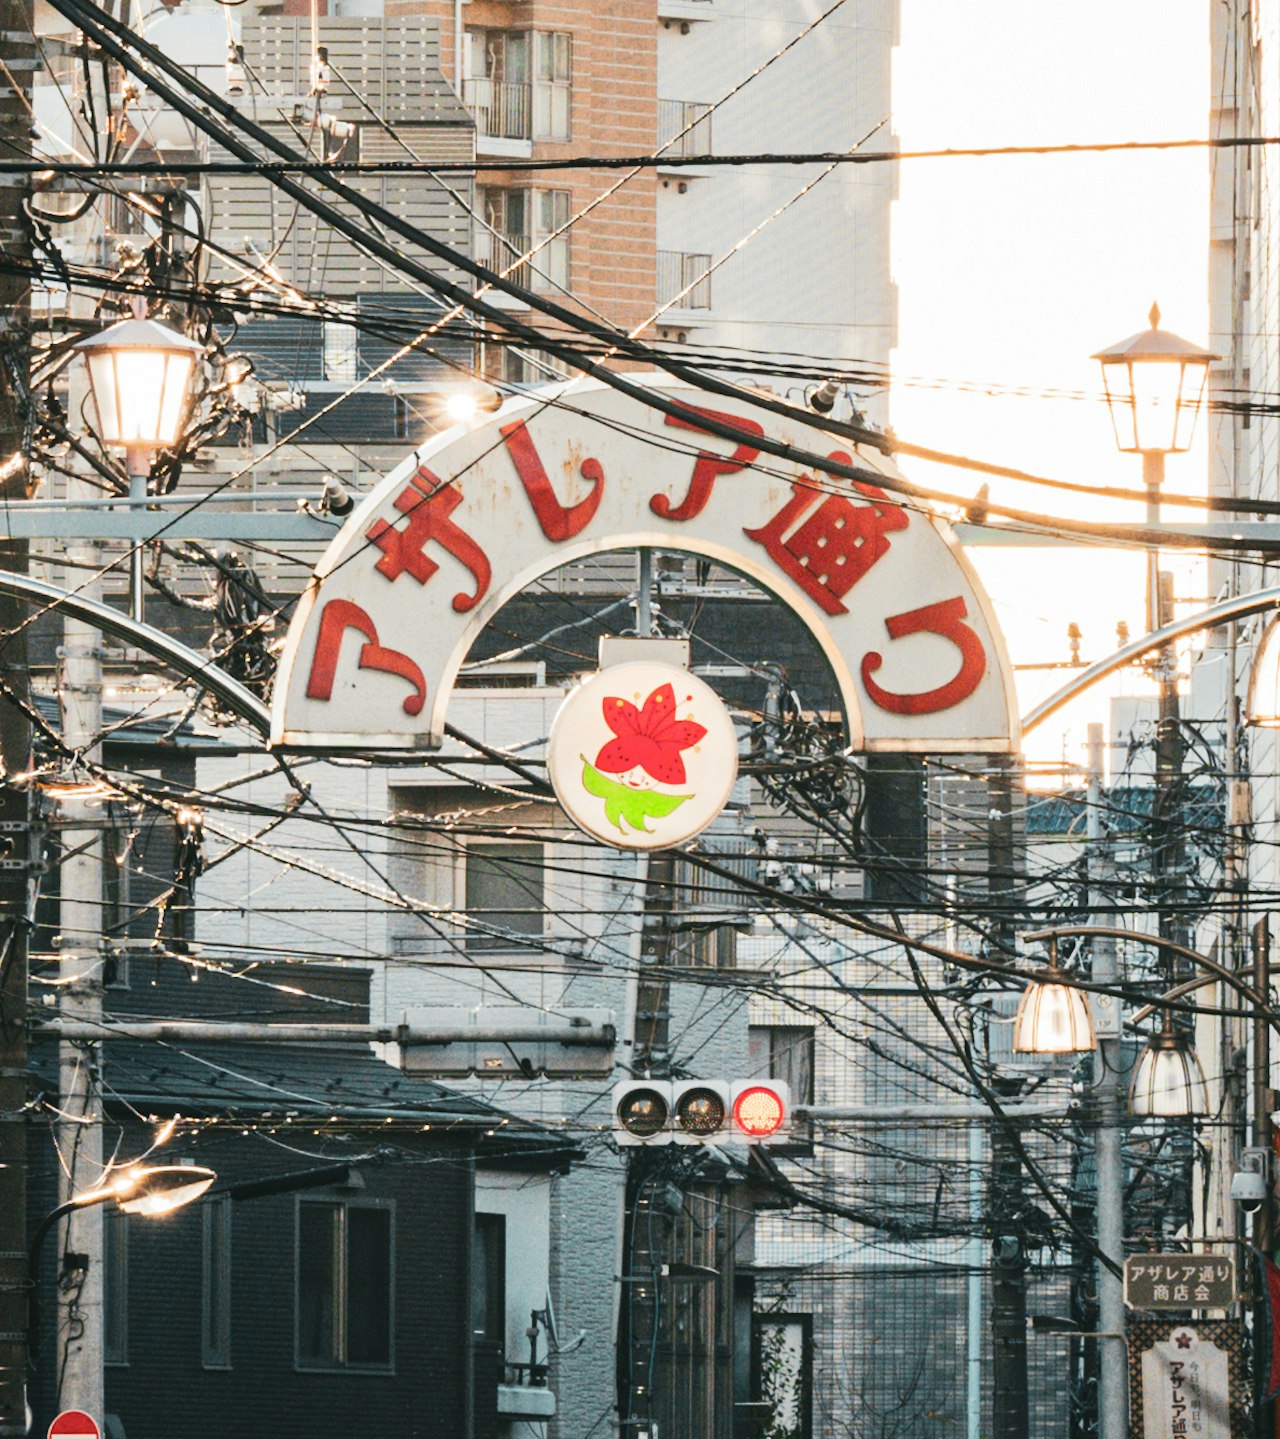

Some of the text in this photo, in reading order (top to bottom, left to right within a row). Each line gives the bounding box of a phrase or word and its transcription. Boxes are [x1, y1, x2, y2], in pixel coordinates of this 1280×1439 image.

[306, 397, 988, 720] アザレア通り
[1130, 1265, 1230, 1283] アザレア通り
[1153, 1284, 1210, 1302] 商店会
